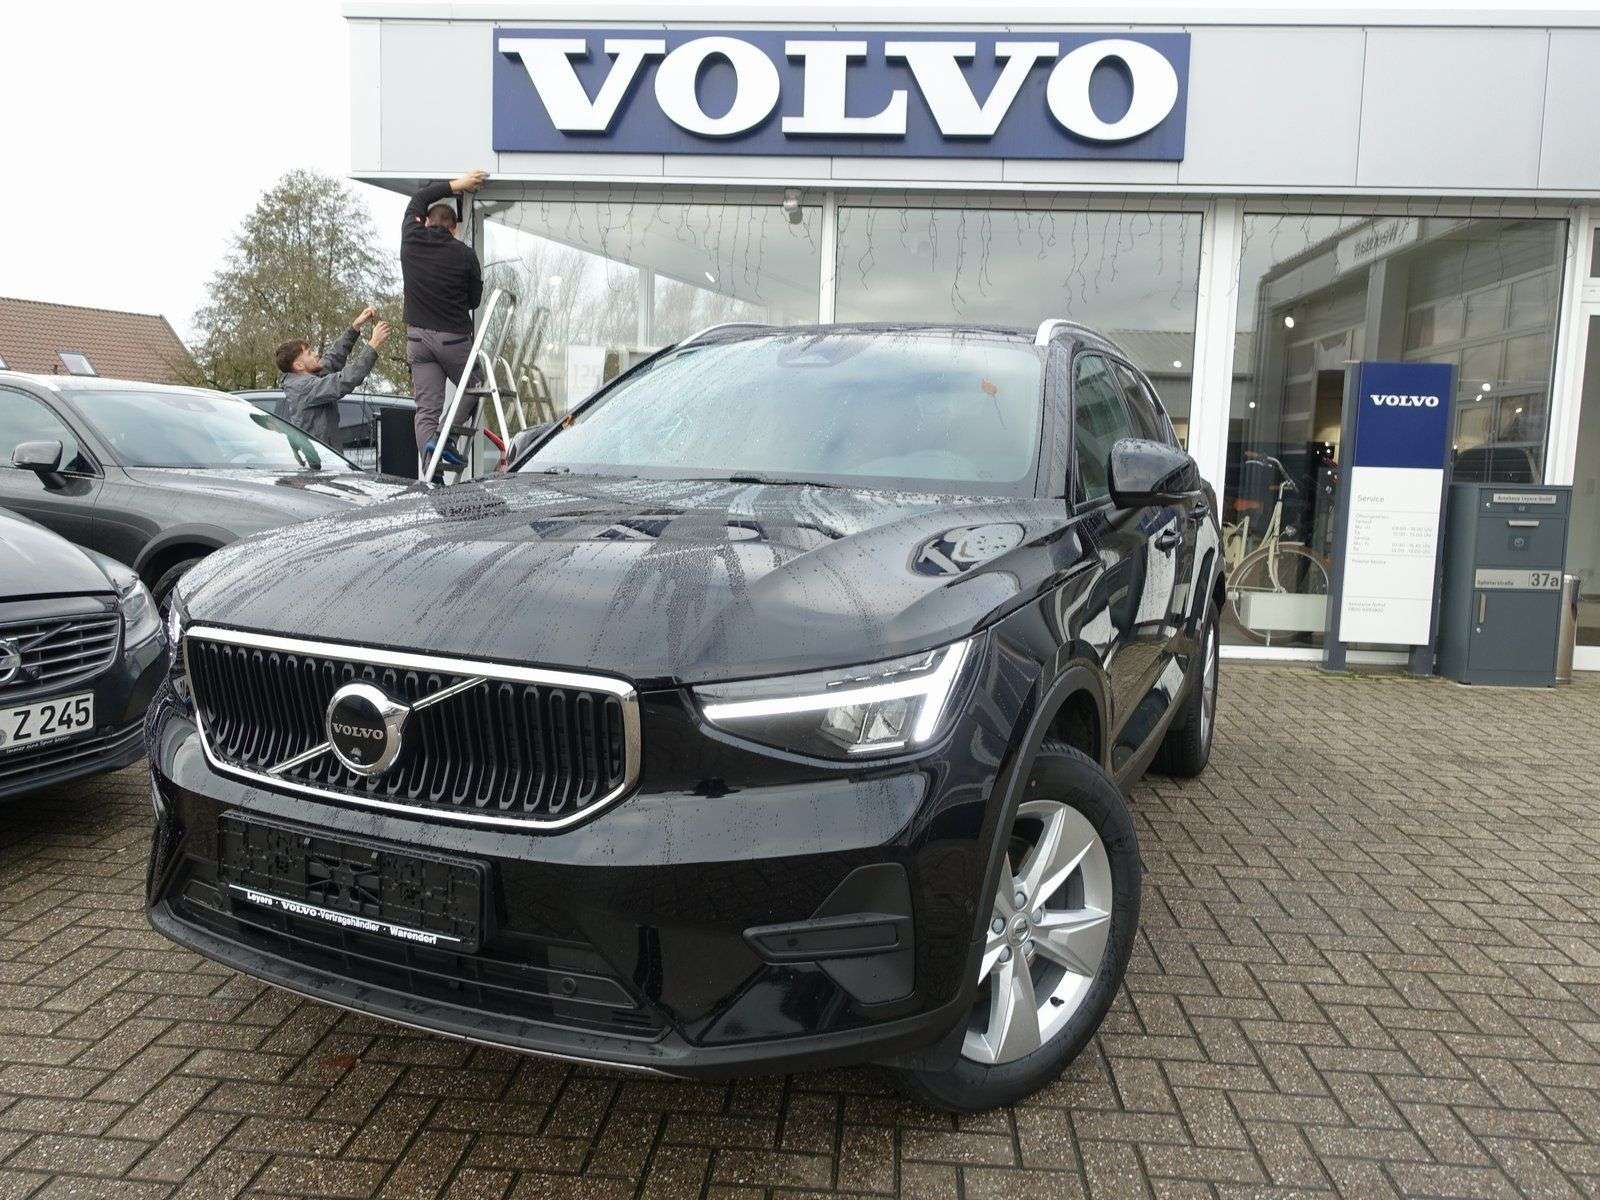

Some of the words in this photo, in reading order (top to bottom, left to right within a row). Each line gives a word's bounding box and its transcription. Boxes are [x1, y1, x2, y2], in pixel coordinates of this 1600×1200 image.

[498, 36, 1178, 140] VOLVO
[1370, 394, 1440, 408] VOLVO
[1531, 573, 1559, 587] 37a
[13, 709, 32, 741] Z
[40, 697, 90, 734] 245
[331, 722, 384, 740] VOLVO
[246, 891, 273, 905] Leyers
[389, 925, 437, 944] Warendorf
